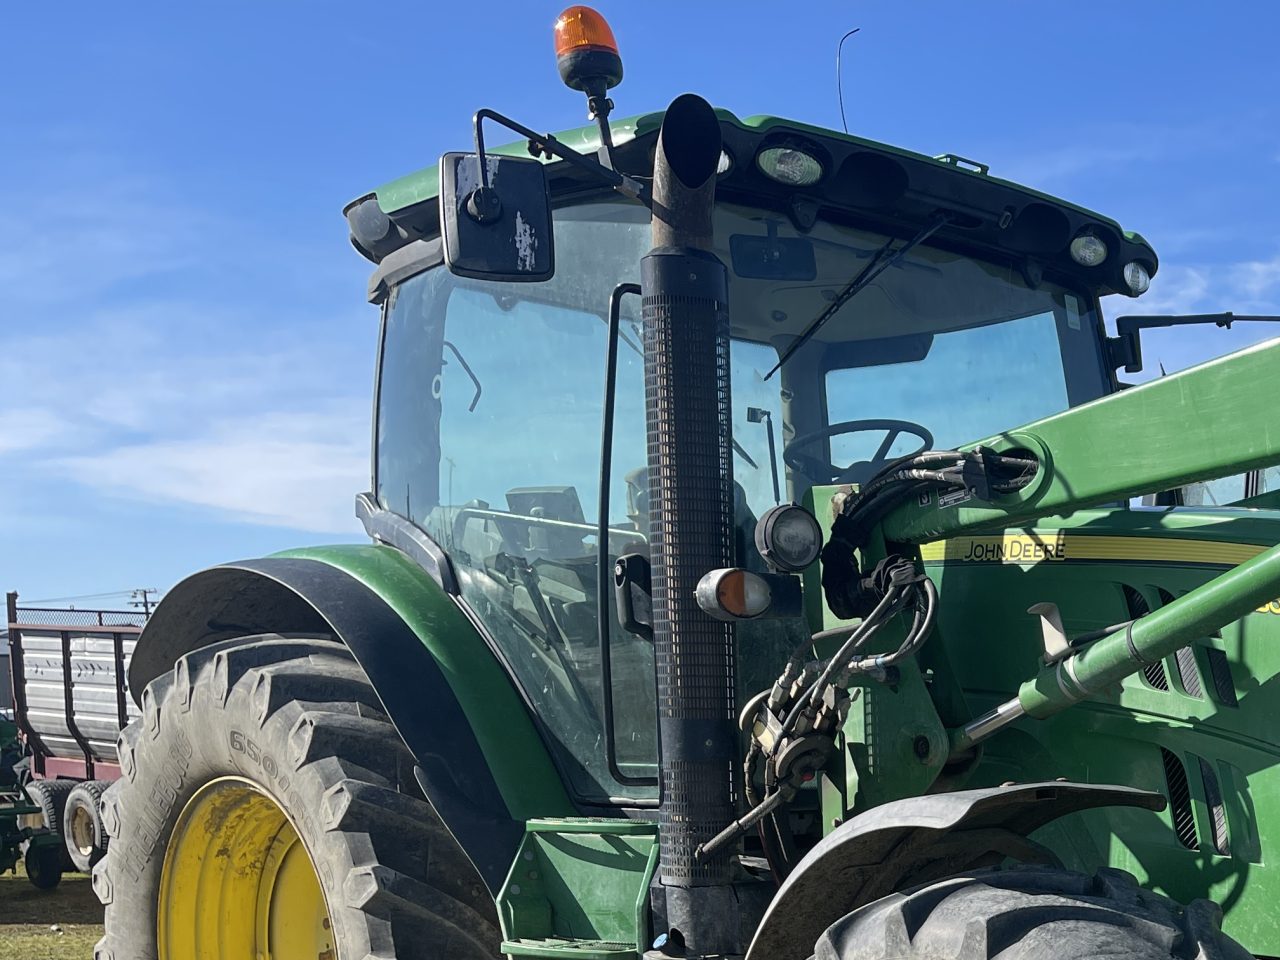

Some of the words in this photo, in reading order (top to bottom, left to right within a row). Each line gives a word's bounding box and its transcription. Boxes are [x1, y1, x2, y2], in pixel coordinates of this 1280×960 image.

[964, 540, 1007, 560] JOHN
[1009, 540, 1066, 560] DEERE
[119, 732, 193, 883] TRELLEBORG
